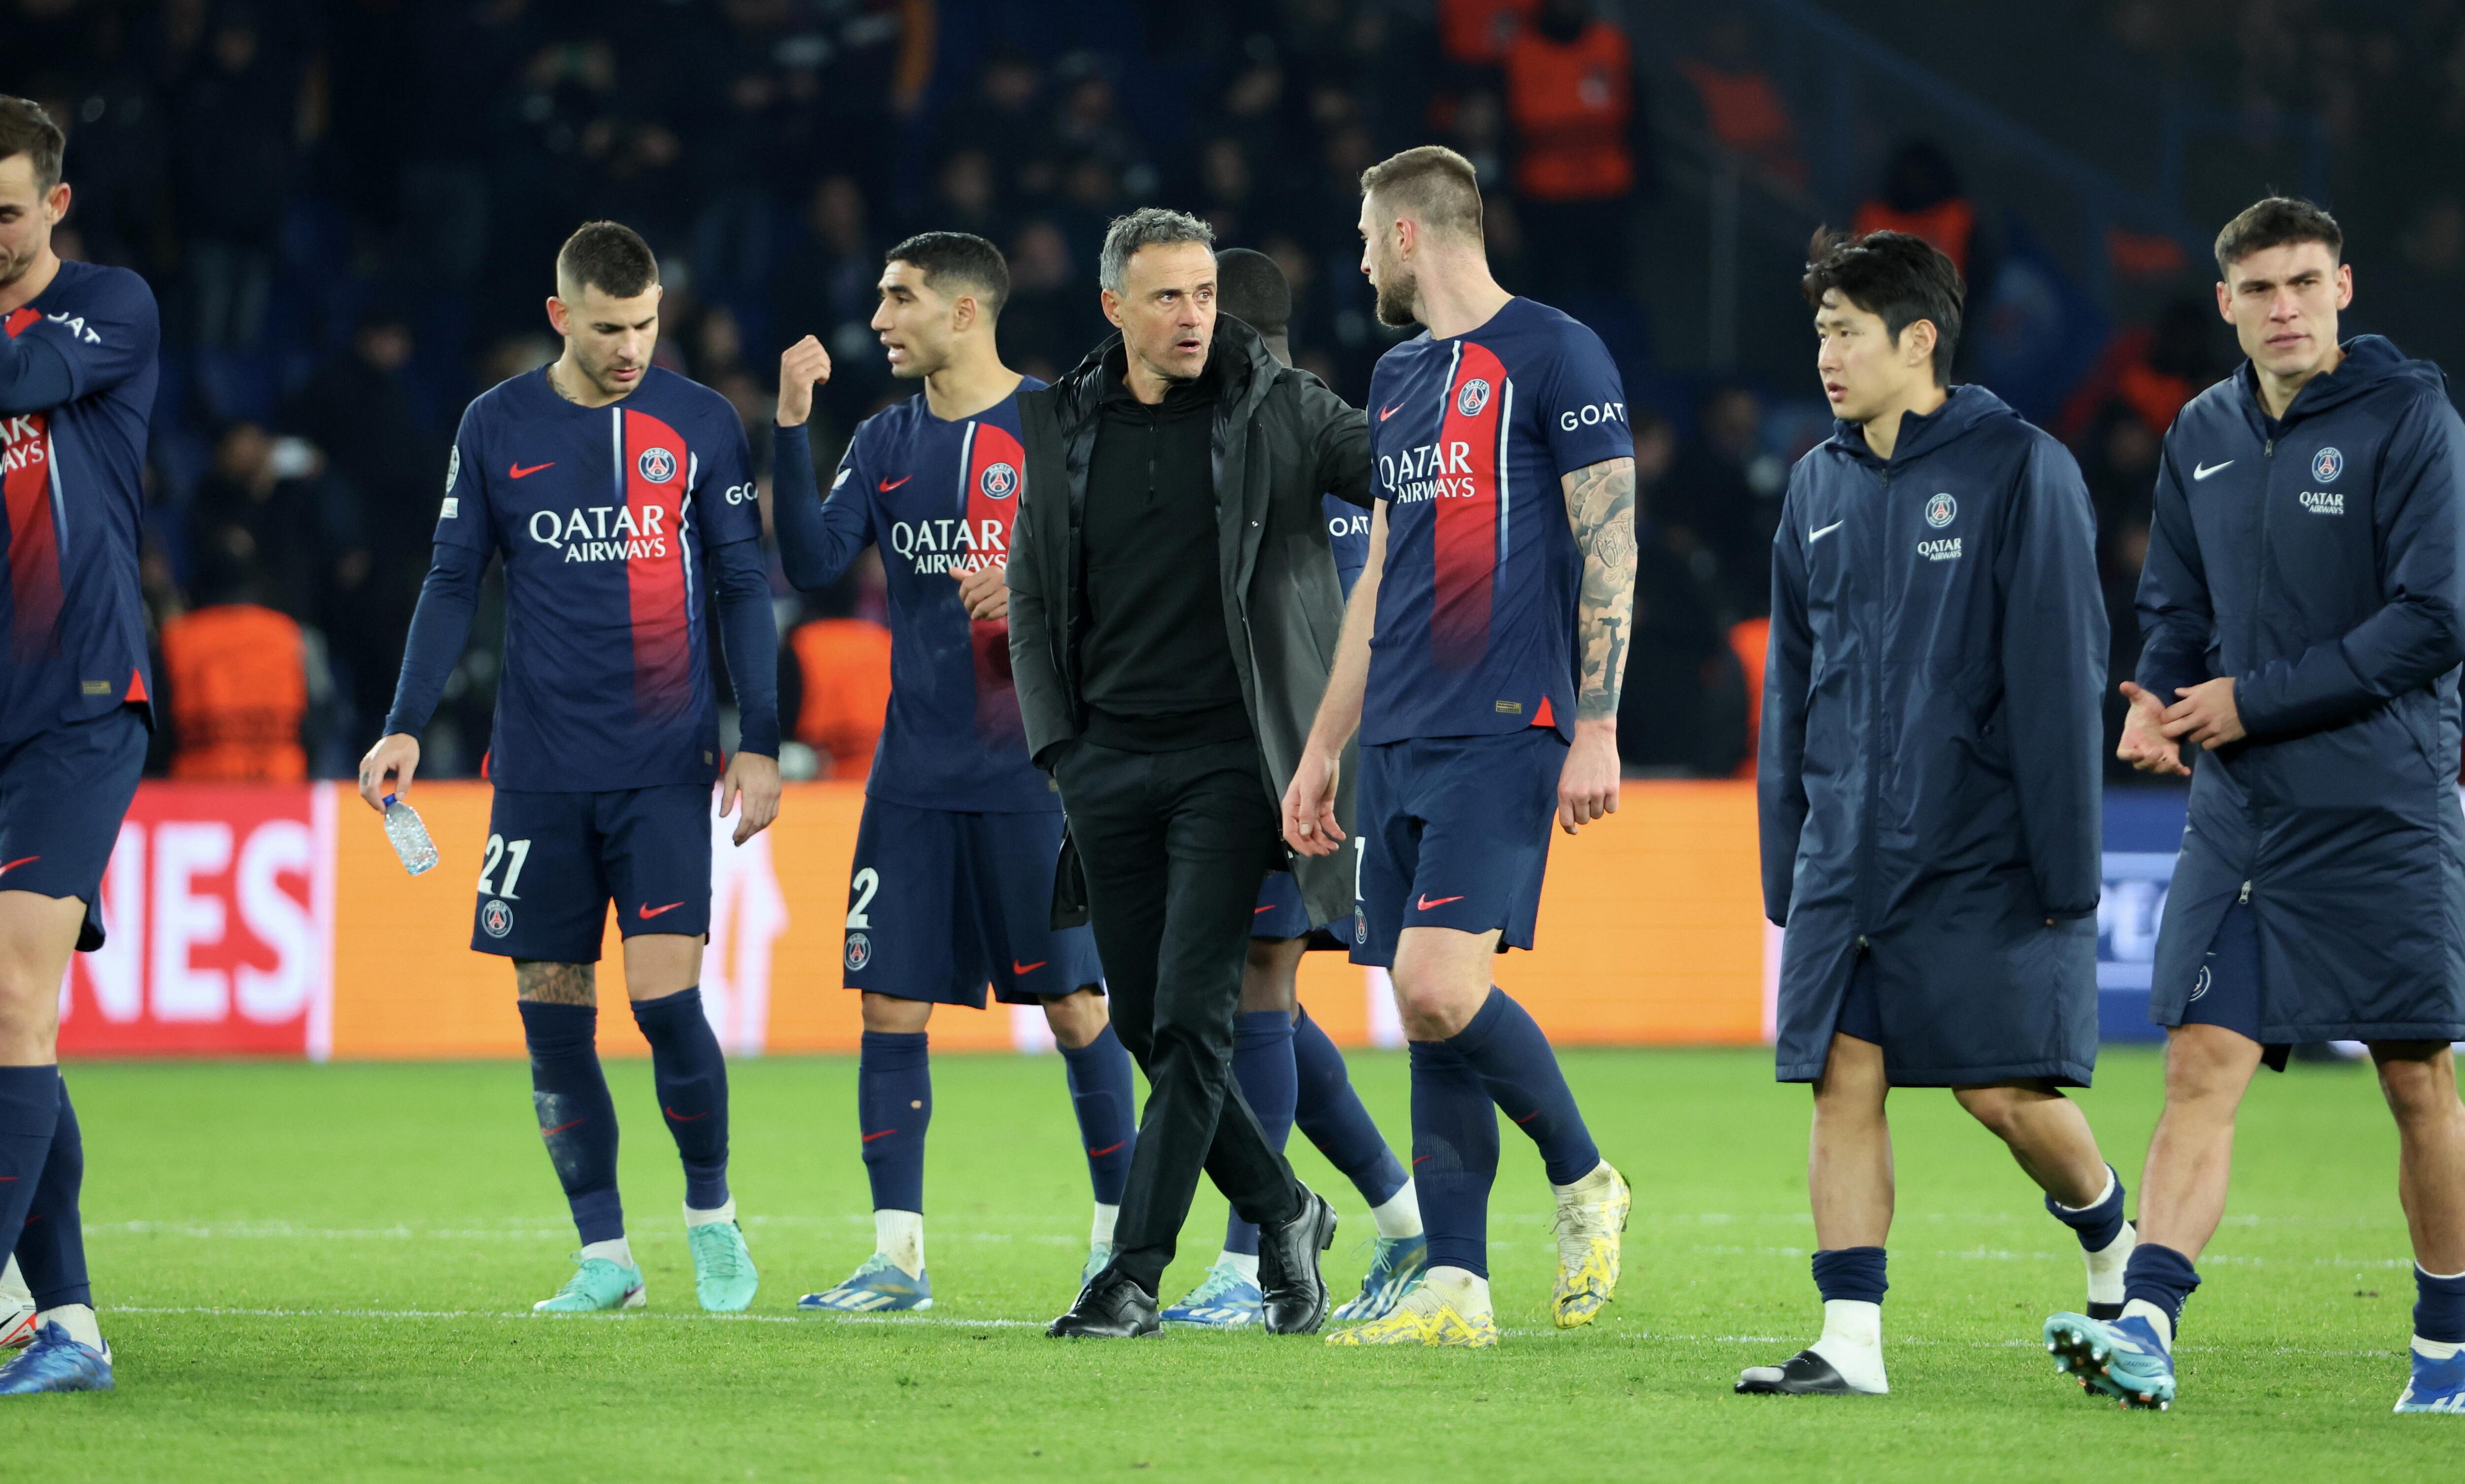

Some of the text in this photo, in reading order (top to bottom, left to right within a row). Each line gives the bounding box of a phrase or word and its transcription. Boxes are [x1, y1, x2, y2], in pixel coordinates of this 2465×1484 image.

[1466, 381, 1487, 390] PARIS
[1561, 402, 1624, 431] GOAT
[1380, 442, 1473, 492] QATAR
[1397, 477, 1475, 504] AIRWAYS
[2299, 491, 2343, 507] QATAR
[2309, 504, 2344, 514] AIRWAYS
[529, 505, 664, 549] QATAR
[892, 519, 1006, 560] QATAR
[1329, 516, 1369, 537] OAT
[565, 537, 666, 563] AIRWAYS
[1917, 538, 1961, 556] QATAR
[1930, 550, 1962, 561] AIRWAYS
[915, 553, 1006, 574] AIRWAYS
[477, 833, 531, 899] 21
[846, 867, 879, 929] 2
